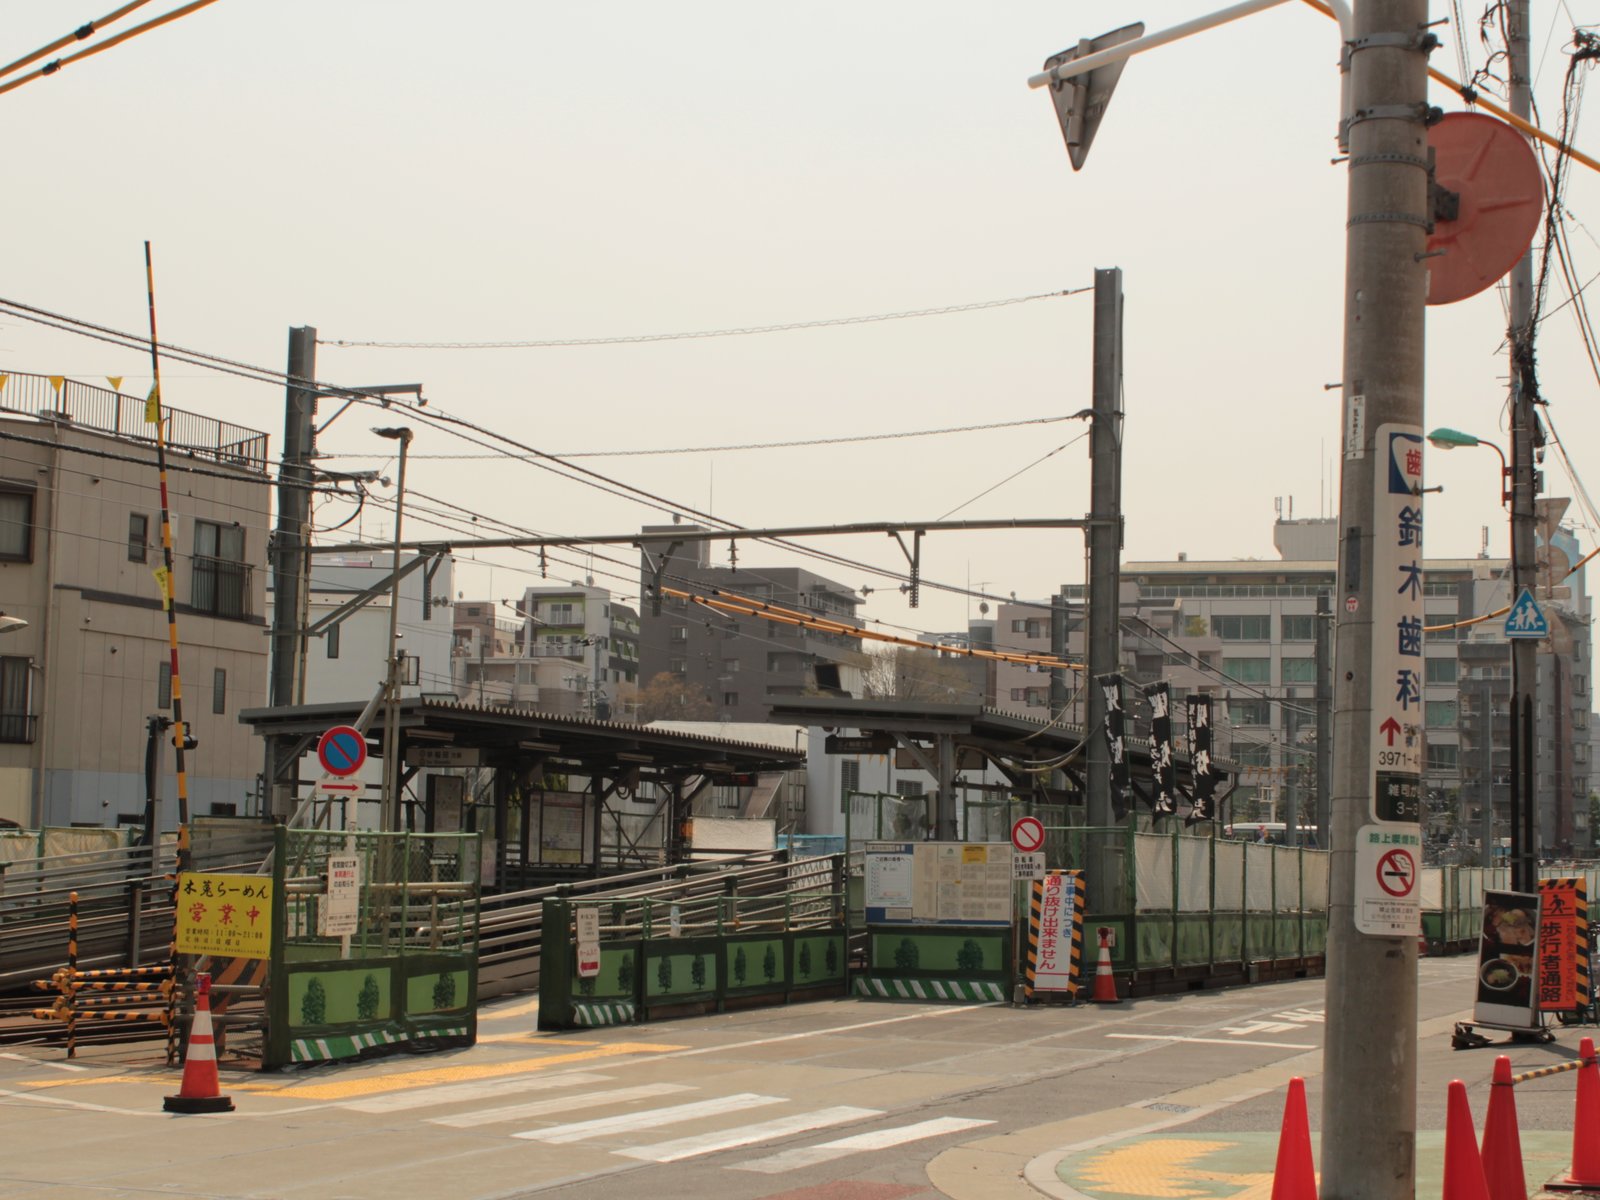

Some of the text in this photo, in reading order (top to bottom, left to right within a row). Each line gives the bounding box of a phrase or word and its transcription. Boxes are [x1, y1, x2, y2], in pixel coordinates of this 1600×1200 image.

[1406, 449, 1422, 476] 歯
[1396, 505, 1422, 712] 鈴木歯科
[188, 902, 261, 928] 営業中
[1039, 875, 1062, 971] 通り抜け出来ません
[1062, 875, 1076, 939] 工事中につき
[1540, 921, 1562, 1003] 歩行者通路
